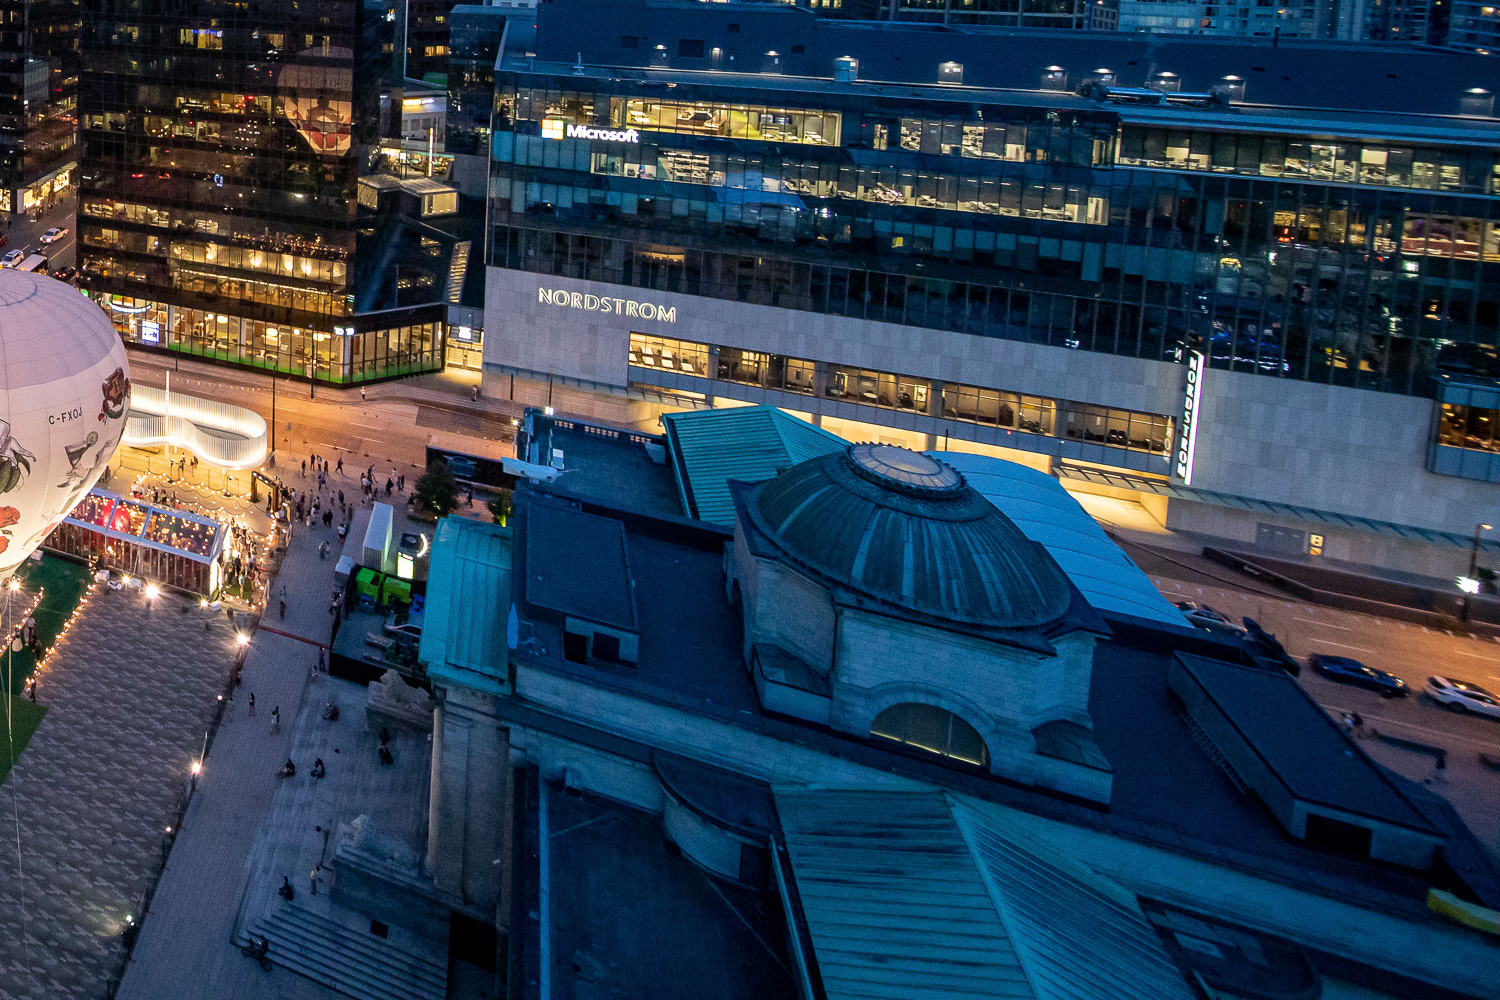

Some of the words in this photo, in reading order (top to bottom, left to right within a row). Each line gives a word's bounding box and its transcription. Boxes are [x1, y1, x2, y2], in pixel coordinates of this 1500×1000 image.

[566, 124, 639, 143] Microsoft
[538, 287, 677, 323] NORDSTROM
[48, 406, 82, 425] C-FXOJ
[1176, 356, 1198, 478] NORDSTROM
